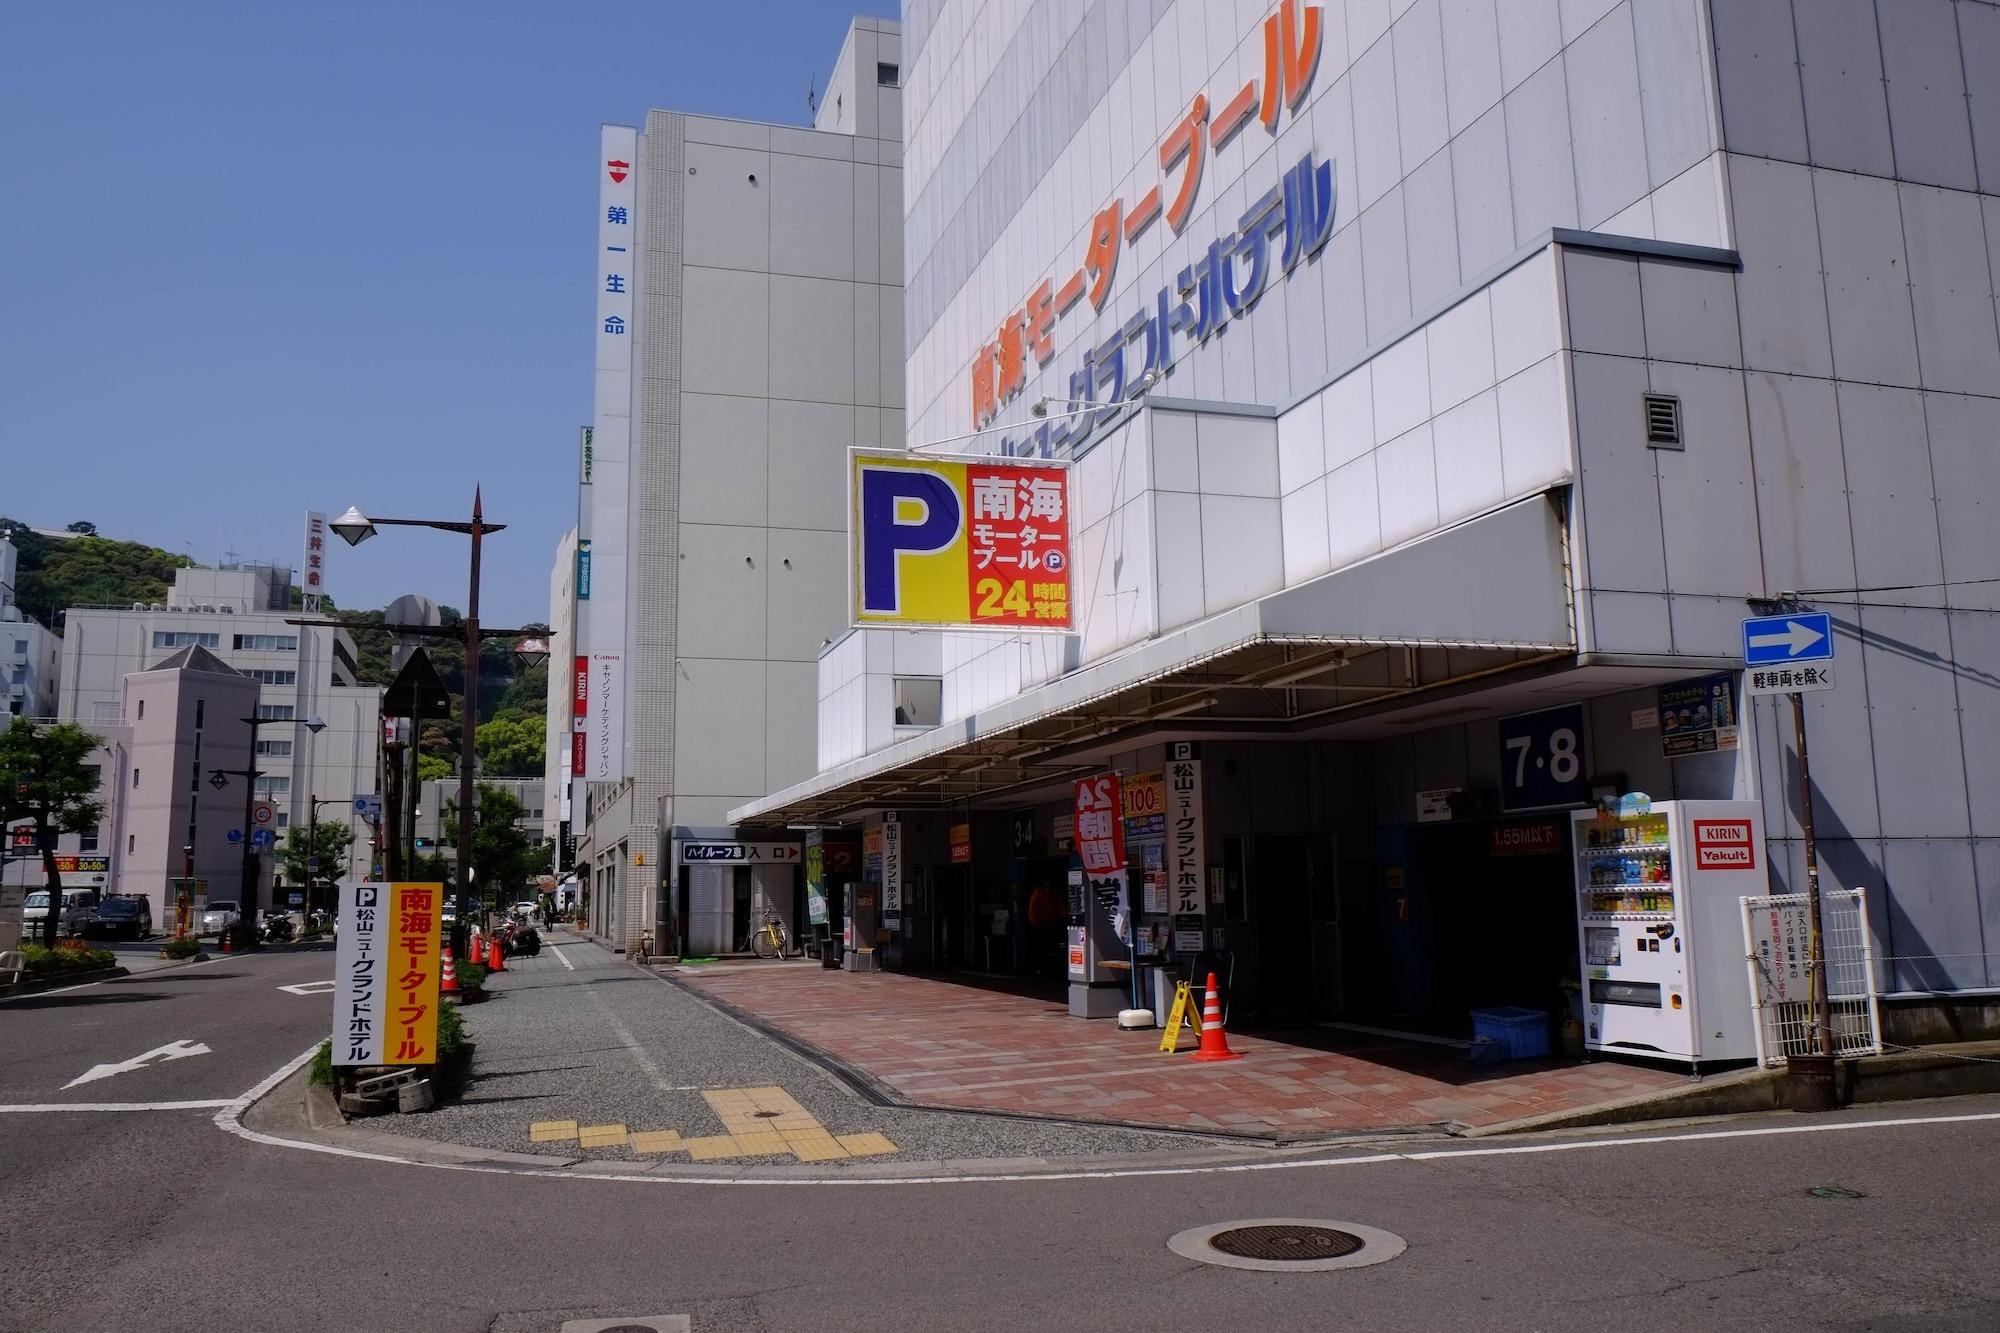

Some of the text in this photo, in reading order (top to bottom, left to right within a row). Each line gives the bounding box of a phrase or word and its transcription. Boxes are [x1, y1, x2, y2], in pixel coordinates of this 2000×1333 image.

[605, 206, 628, 335] 第一生命
[972, 476, 1063, 522] 南海
[860, 464, 964, 615] P
[973, 524, 1061, 547] モーター
[308, 519, 322, 586] 三井生命
[974, 547, 1041, 570] プール
[976, 578, 1030, 618] 24
[1033, 583, 1066, 601] 時間
[593, 653, 620, 661] Canon
[578, 672, 587, 701] KIRIN
[1753, 667, 1828, 689] 軽車両を除く
[258, 809, 267, 819] 40
[1173, 763, 1198, 913] 松山ニューグランドホテル
[1706, 828, 1741, 840] KIRIN
[688, 846, 742, 859] ハイルーフ車
[749, 846, 785, 859] 入口
[1703, 850, 1748, 861] Yakult
[886, 824, 897, 909] 松山ニューグランドホテル
[348, 909, 376, 1061] 松山ニューグランドホテル
[395, 888, 433, 1060] 南海モータープール
